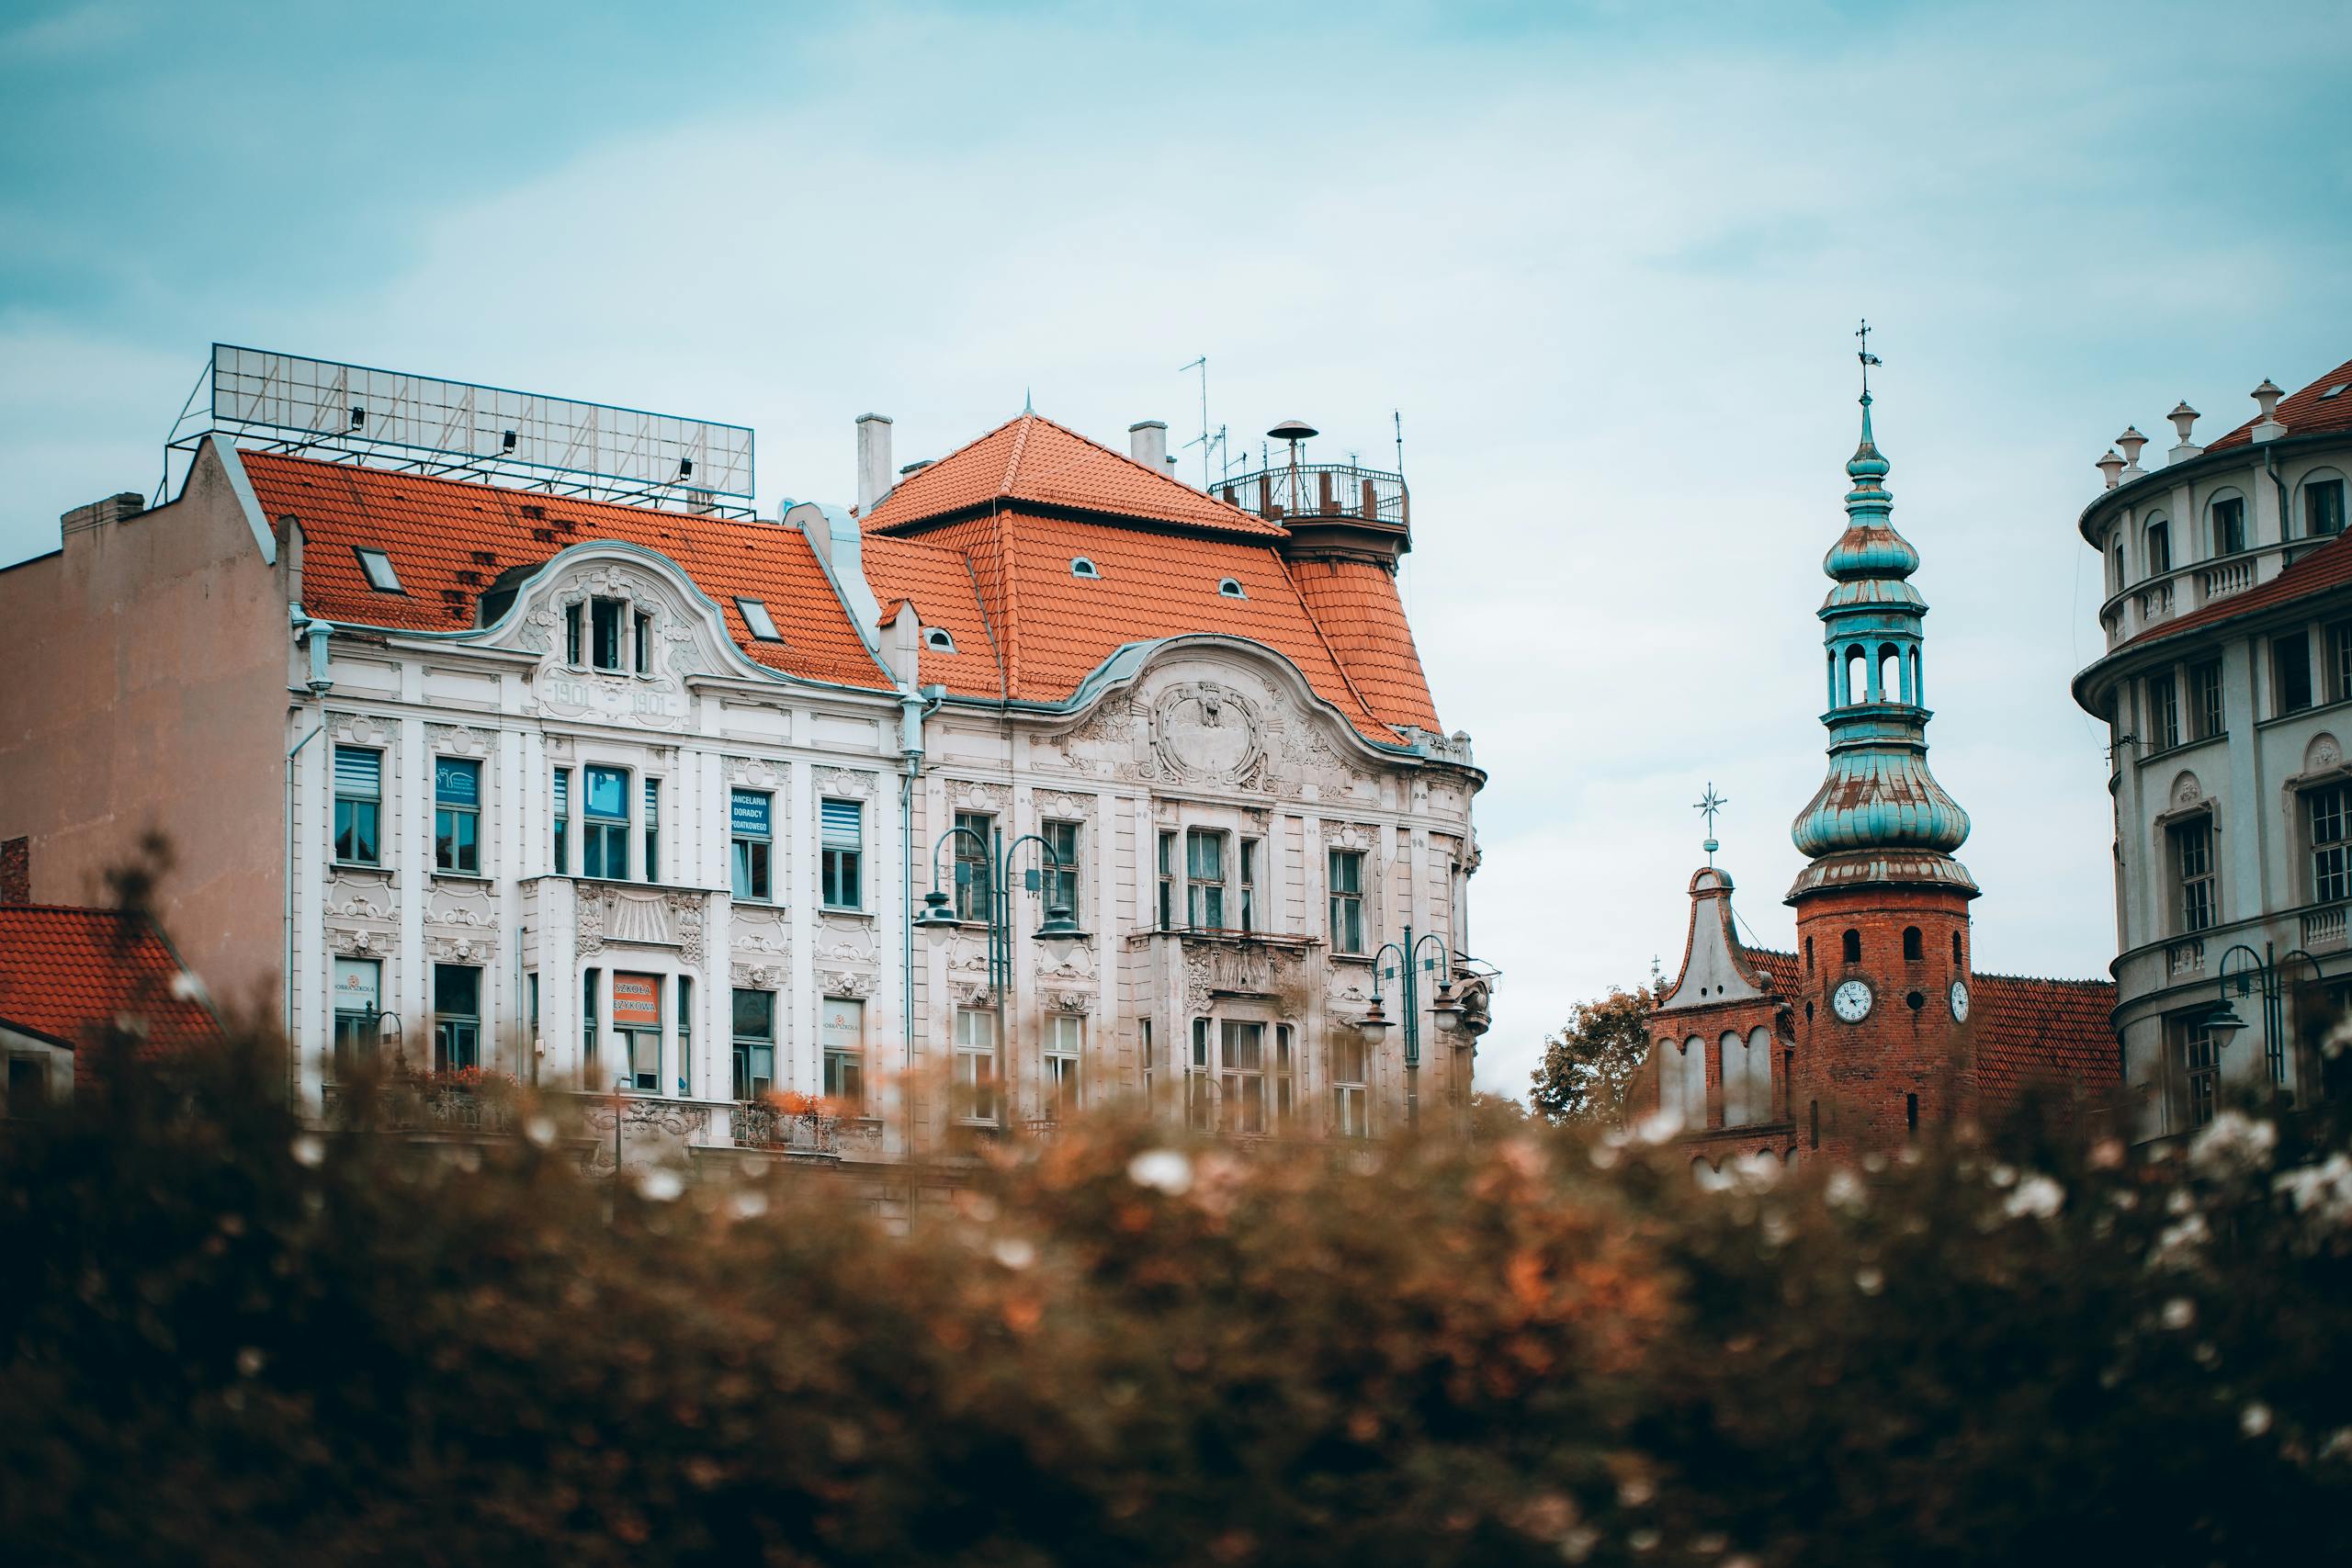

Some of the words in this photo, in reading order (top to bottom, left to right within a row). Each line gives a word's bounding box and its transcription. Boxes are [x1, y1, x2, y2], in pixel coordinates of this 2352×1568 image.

[554, 683, 589, 706] 1901
[632, 693, 666, 716] 1901
[734, 807, 763, 818] DORADCY
[616, 983, 651, 995] SZKOŁA
